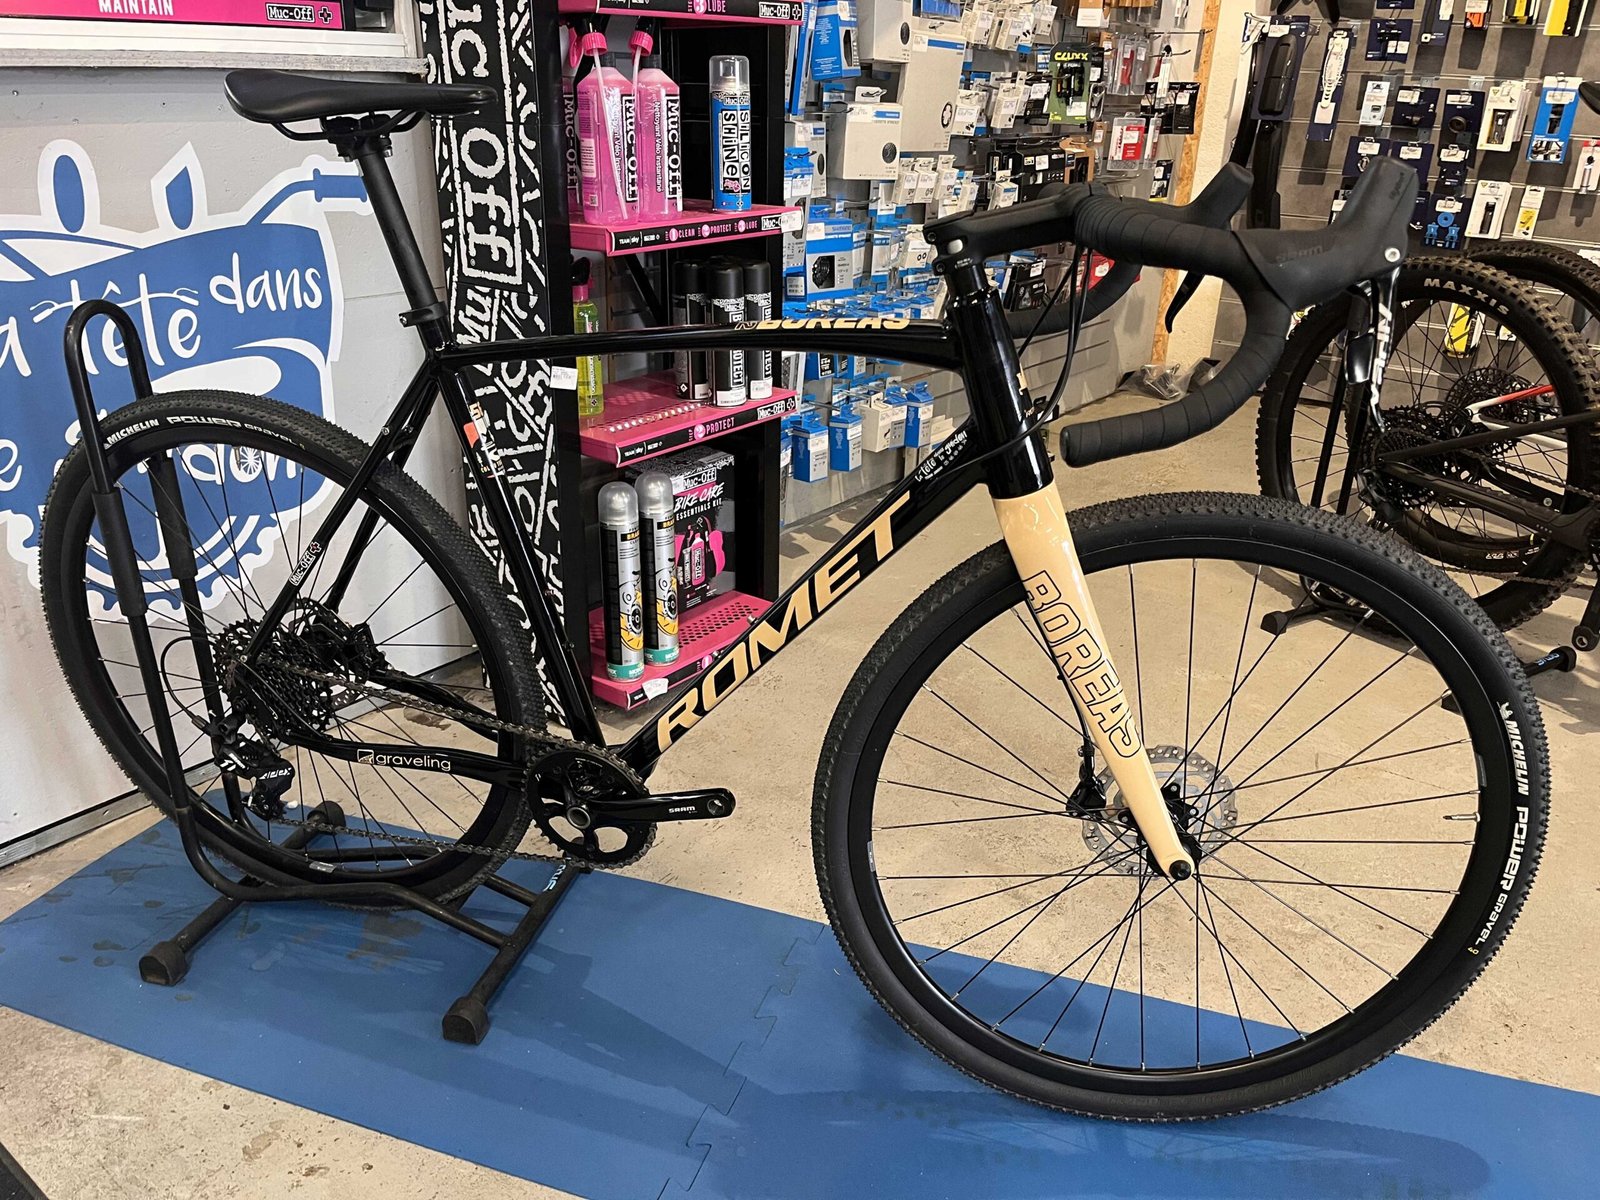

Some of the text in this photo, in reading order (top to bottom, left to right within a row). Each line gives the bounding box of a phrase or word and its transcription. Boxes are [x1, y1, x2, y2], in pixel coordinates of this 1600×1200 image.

[98, 0, 174, 16] MAINTAIN
[267, 5, 313, 21] Muc-Off
[707, 0, 726, 13] LUBE
[760, 3, 790, 18] Muc-Off
[624, 100, 638, 198] Muc-Off
[667, 100, 682, 196] Muc-Off
[710, 223, 732, 235] PROTECT
[763, 215, 783, 229] Muc-
[209, 252, 323, 314] dans
[1423, 278, 1510, 315] MAXXIS
[106, 418, 160, 446] MICHELIN
[706, 416, 735, 435] PROTECT
[673, 482, 725, 513] BIKE CARE
[676, 504, 711, 521] ESSENTIALS
[289, 552, 318, 587] Muc-Off
[656, 490, 911, 753] ROMET
[1021, 569, 1143, 758] BOREAS
[375, 752, 452, 771] graveling
[1504, 719, 1530, 797] MICHELIN
[668, 805, 697, 814] SRAM
[1500, 806, 1530, 892] POWER
